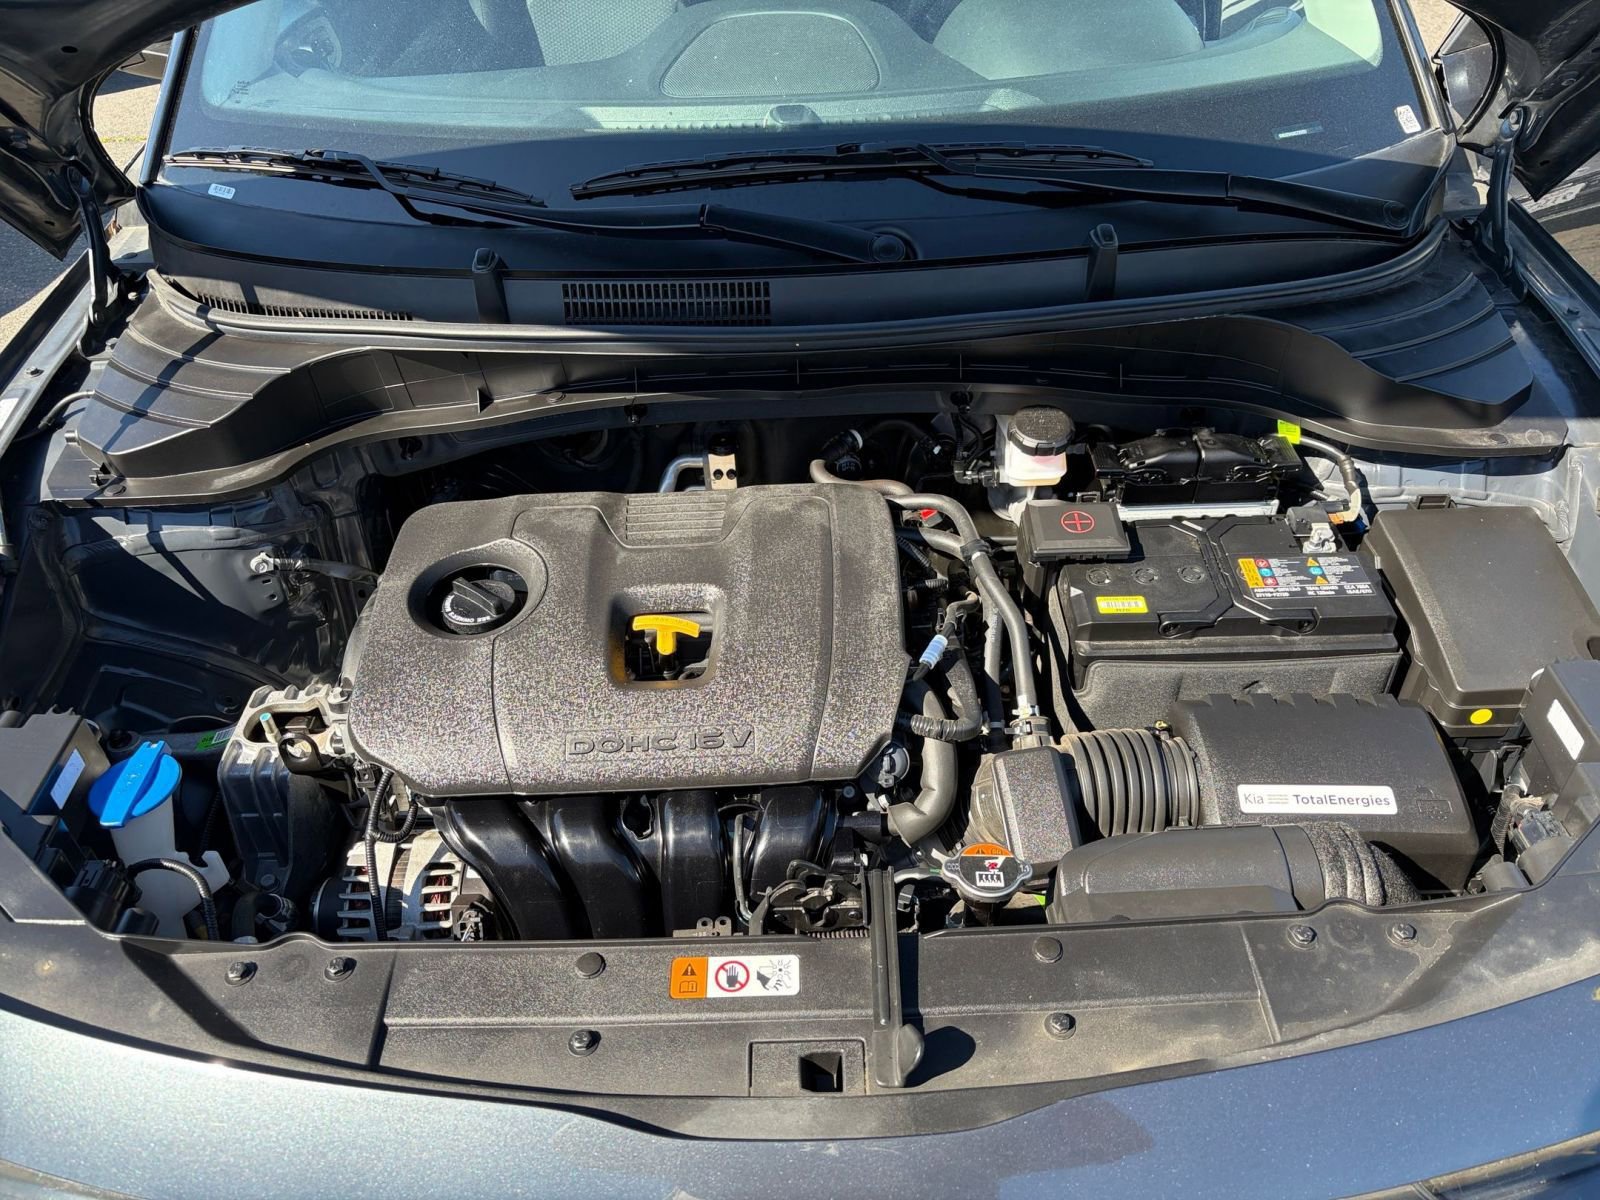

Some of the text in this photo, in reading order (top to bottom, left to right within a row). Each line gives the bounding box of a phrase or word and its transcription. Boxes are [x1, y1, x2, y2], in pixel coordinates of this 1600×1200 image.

[568, 728, 753, 755] DOHC 16V
[1243, 793, 1391, 807] Kia TotalEnergies
